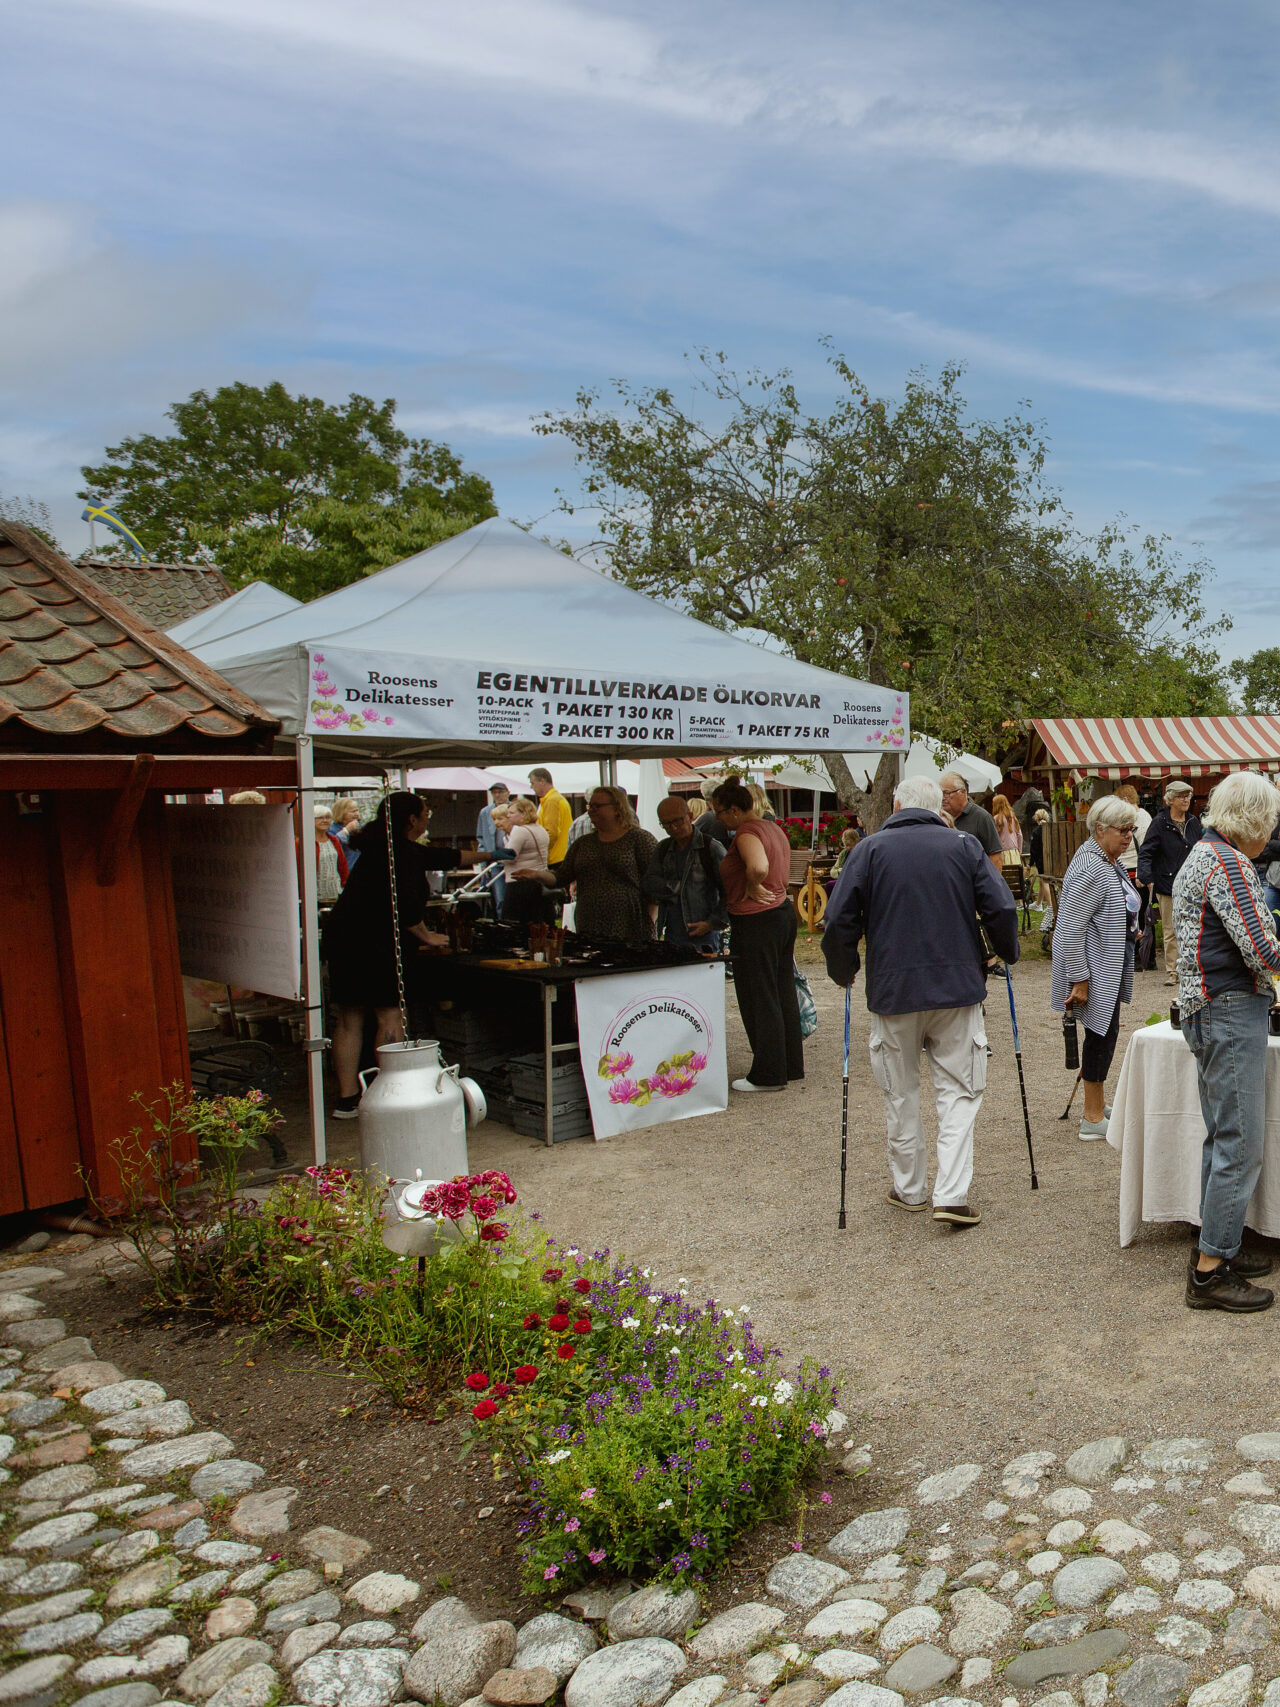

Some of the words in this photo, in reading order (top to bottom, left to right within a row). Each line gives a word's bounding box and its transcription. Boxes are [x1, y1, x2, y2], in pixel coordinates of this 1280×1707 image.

[367, 671, 438, 689] Roosens
[345, 688, 454, 707] Delikatesser
[476, 671, 708, 702] EGENTILLVERKADE
[713, 684, 821, 709] ÖLKORVAR
[477, 695, 534, 708] 10-PACK
[843, 701, 882, 713] Roosens
[541, 701, 550, 715] 1
[556, 703, 614, 718] PAKET
[618, 705, 648, 719] 130
[651, 707, 674, 721] KR
[689, 715, 726, 726] 5-PACK
[833, 714, 890, 727] Delikatesser
[541, 722, 553, 737] 3
[558, 723, 614, 739] PAKET
[617, 726, 648, 740] 300
[652, 727, 675, 741] KR
[736, 723, 744, 736] 1
[748, 724, 791, 738] PAKET
[794, 726, 810, 738] 75
[813, 726, 830, 739] KR
[610, 1009, 647, 1047] Roosens
[648, 1002, 703, 1034] Delikatesser
